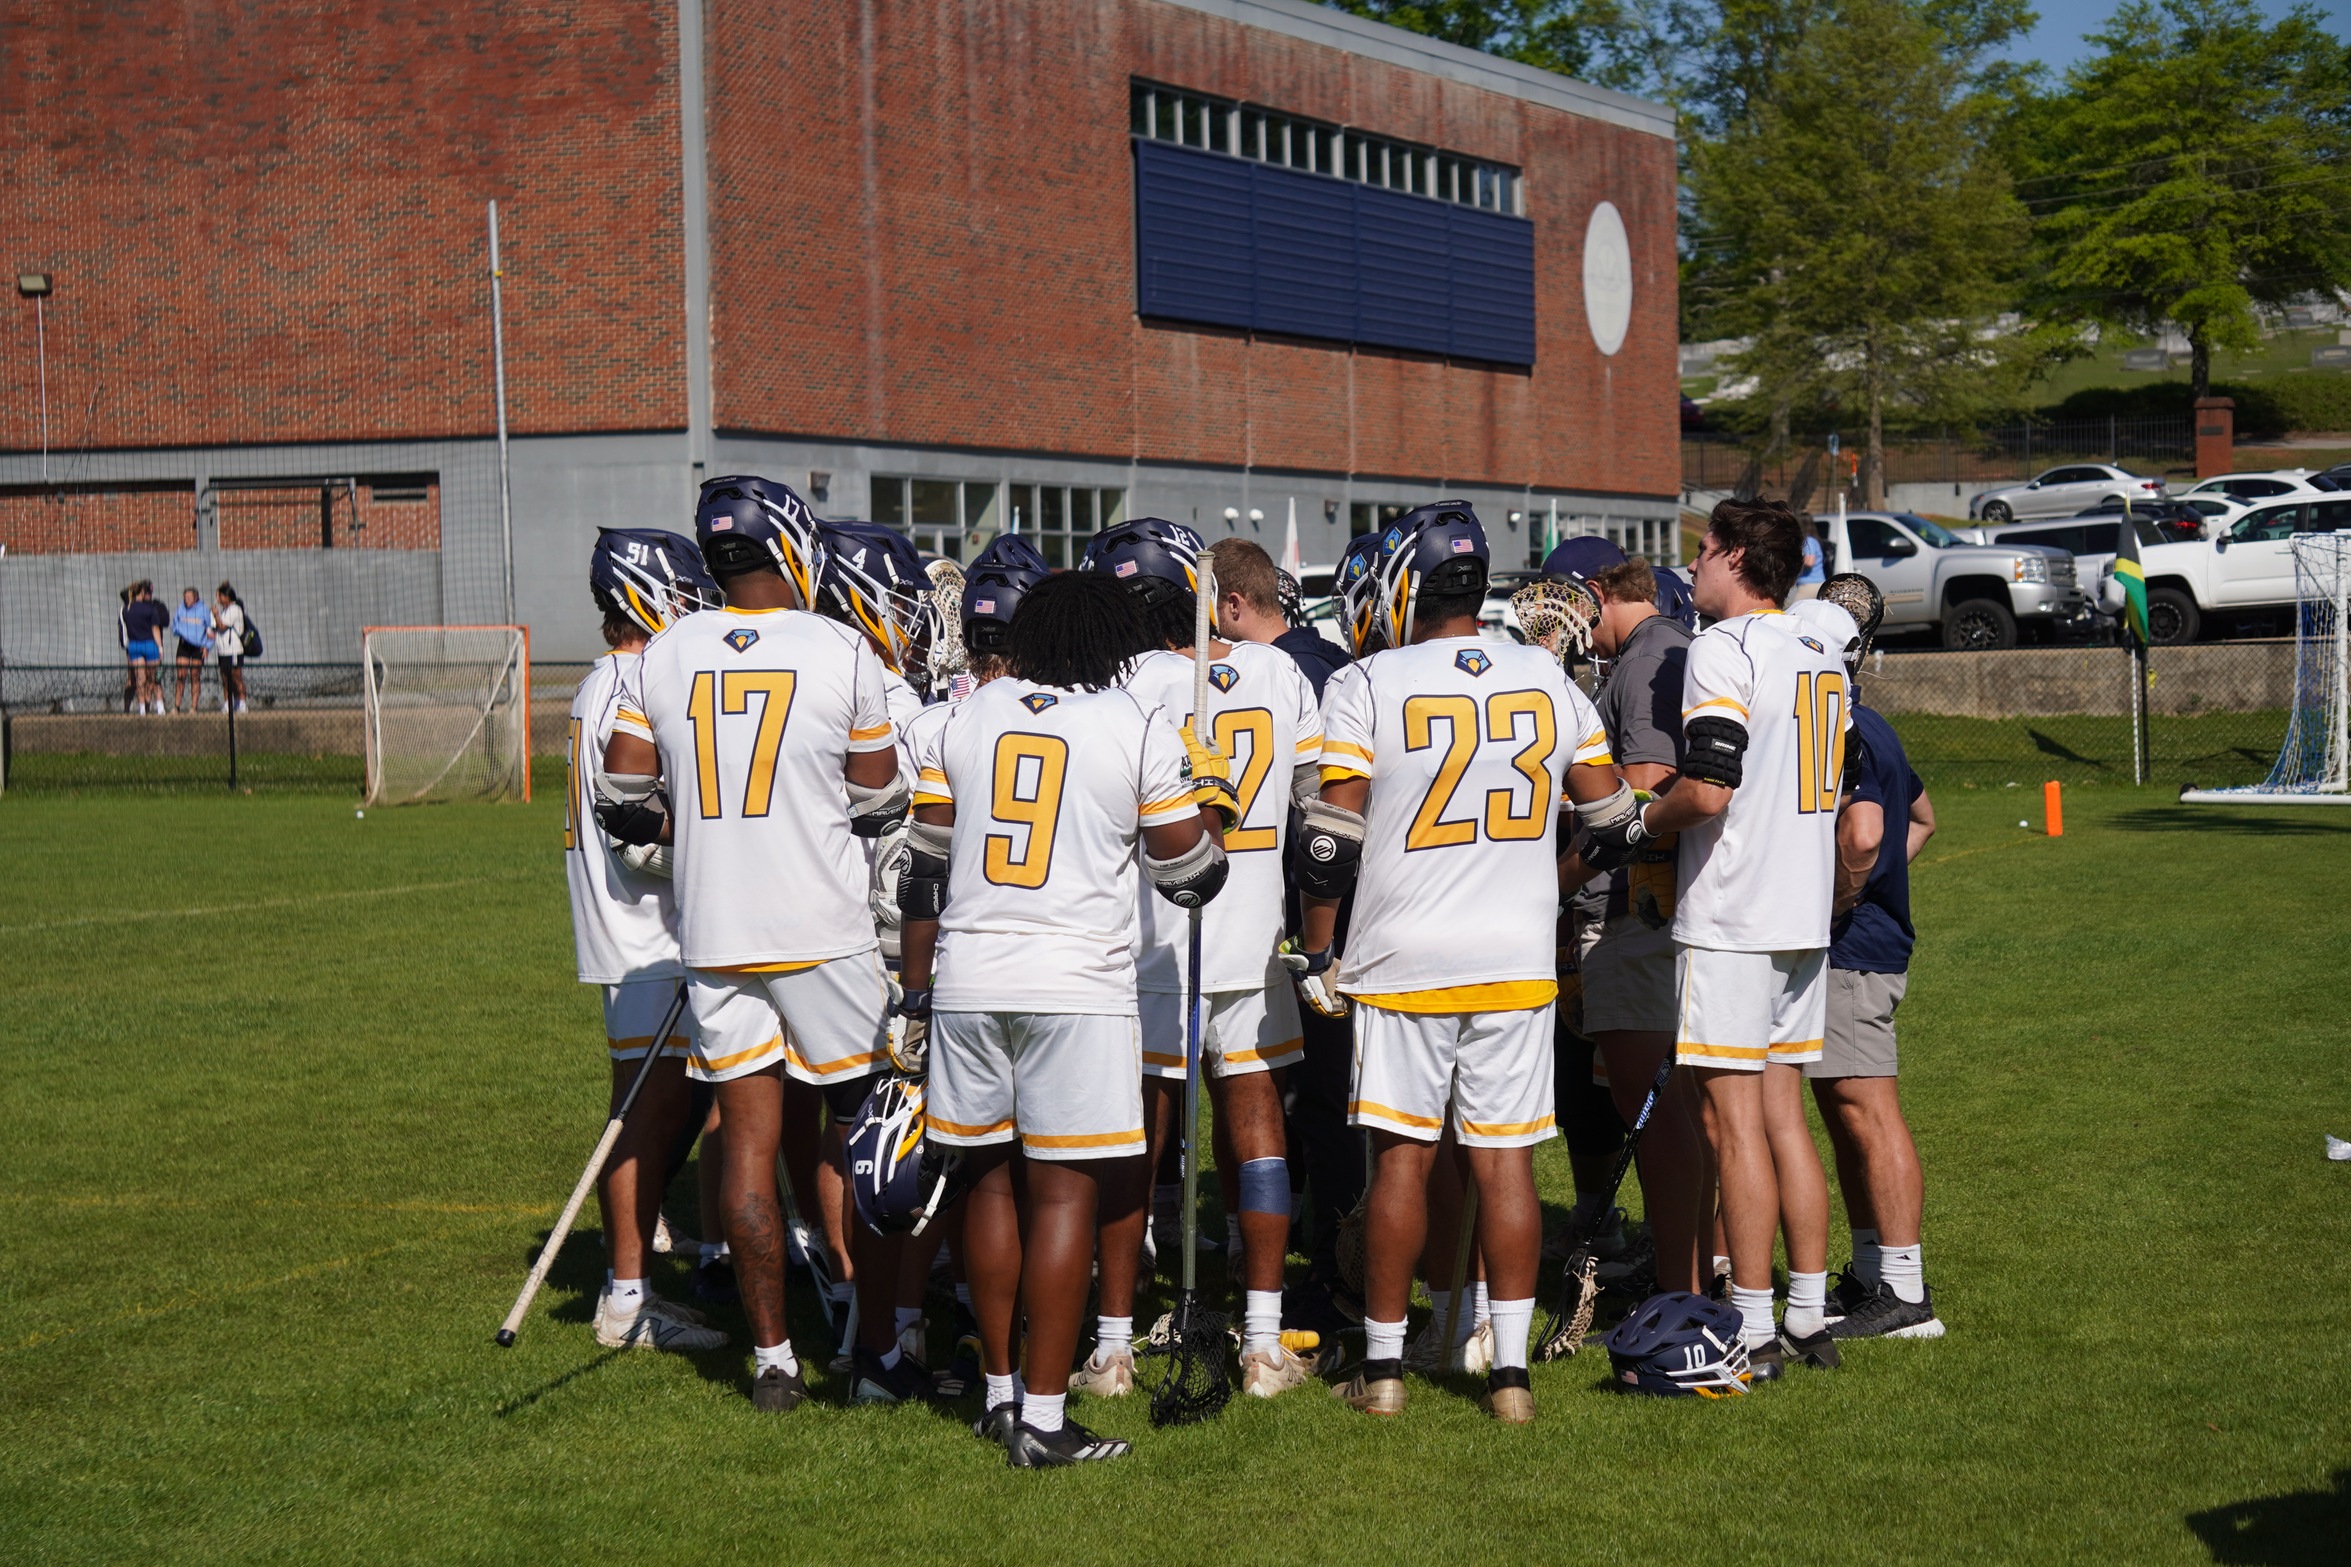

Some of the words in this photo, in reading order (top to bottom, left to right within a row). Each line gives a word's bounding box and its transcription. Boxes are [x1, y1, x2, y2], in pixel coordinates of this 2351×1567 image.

[783, 494, 800, 520] 17
[1169, 524, 1190, 546] 12
[626, 542, 649, 566] 51
[852, 548, 867, 570] 4
[687, 669, 797, 820] 17
[1714, 741, 1737, 751] BRINE
[1794, 671, 1846, 814] 10
[1184, 706, 1277, 853] 2
[1402, 688, 1556, 853] 23
[983, 731, 1069, 889] 9
[1684, 1343, 1707, 1370] 10
